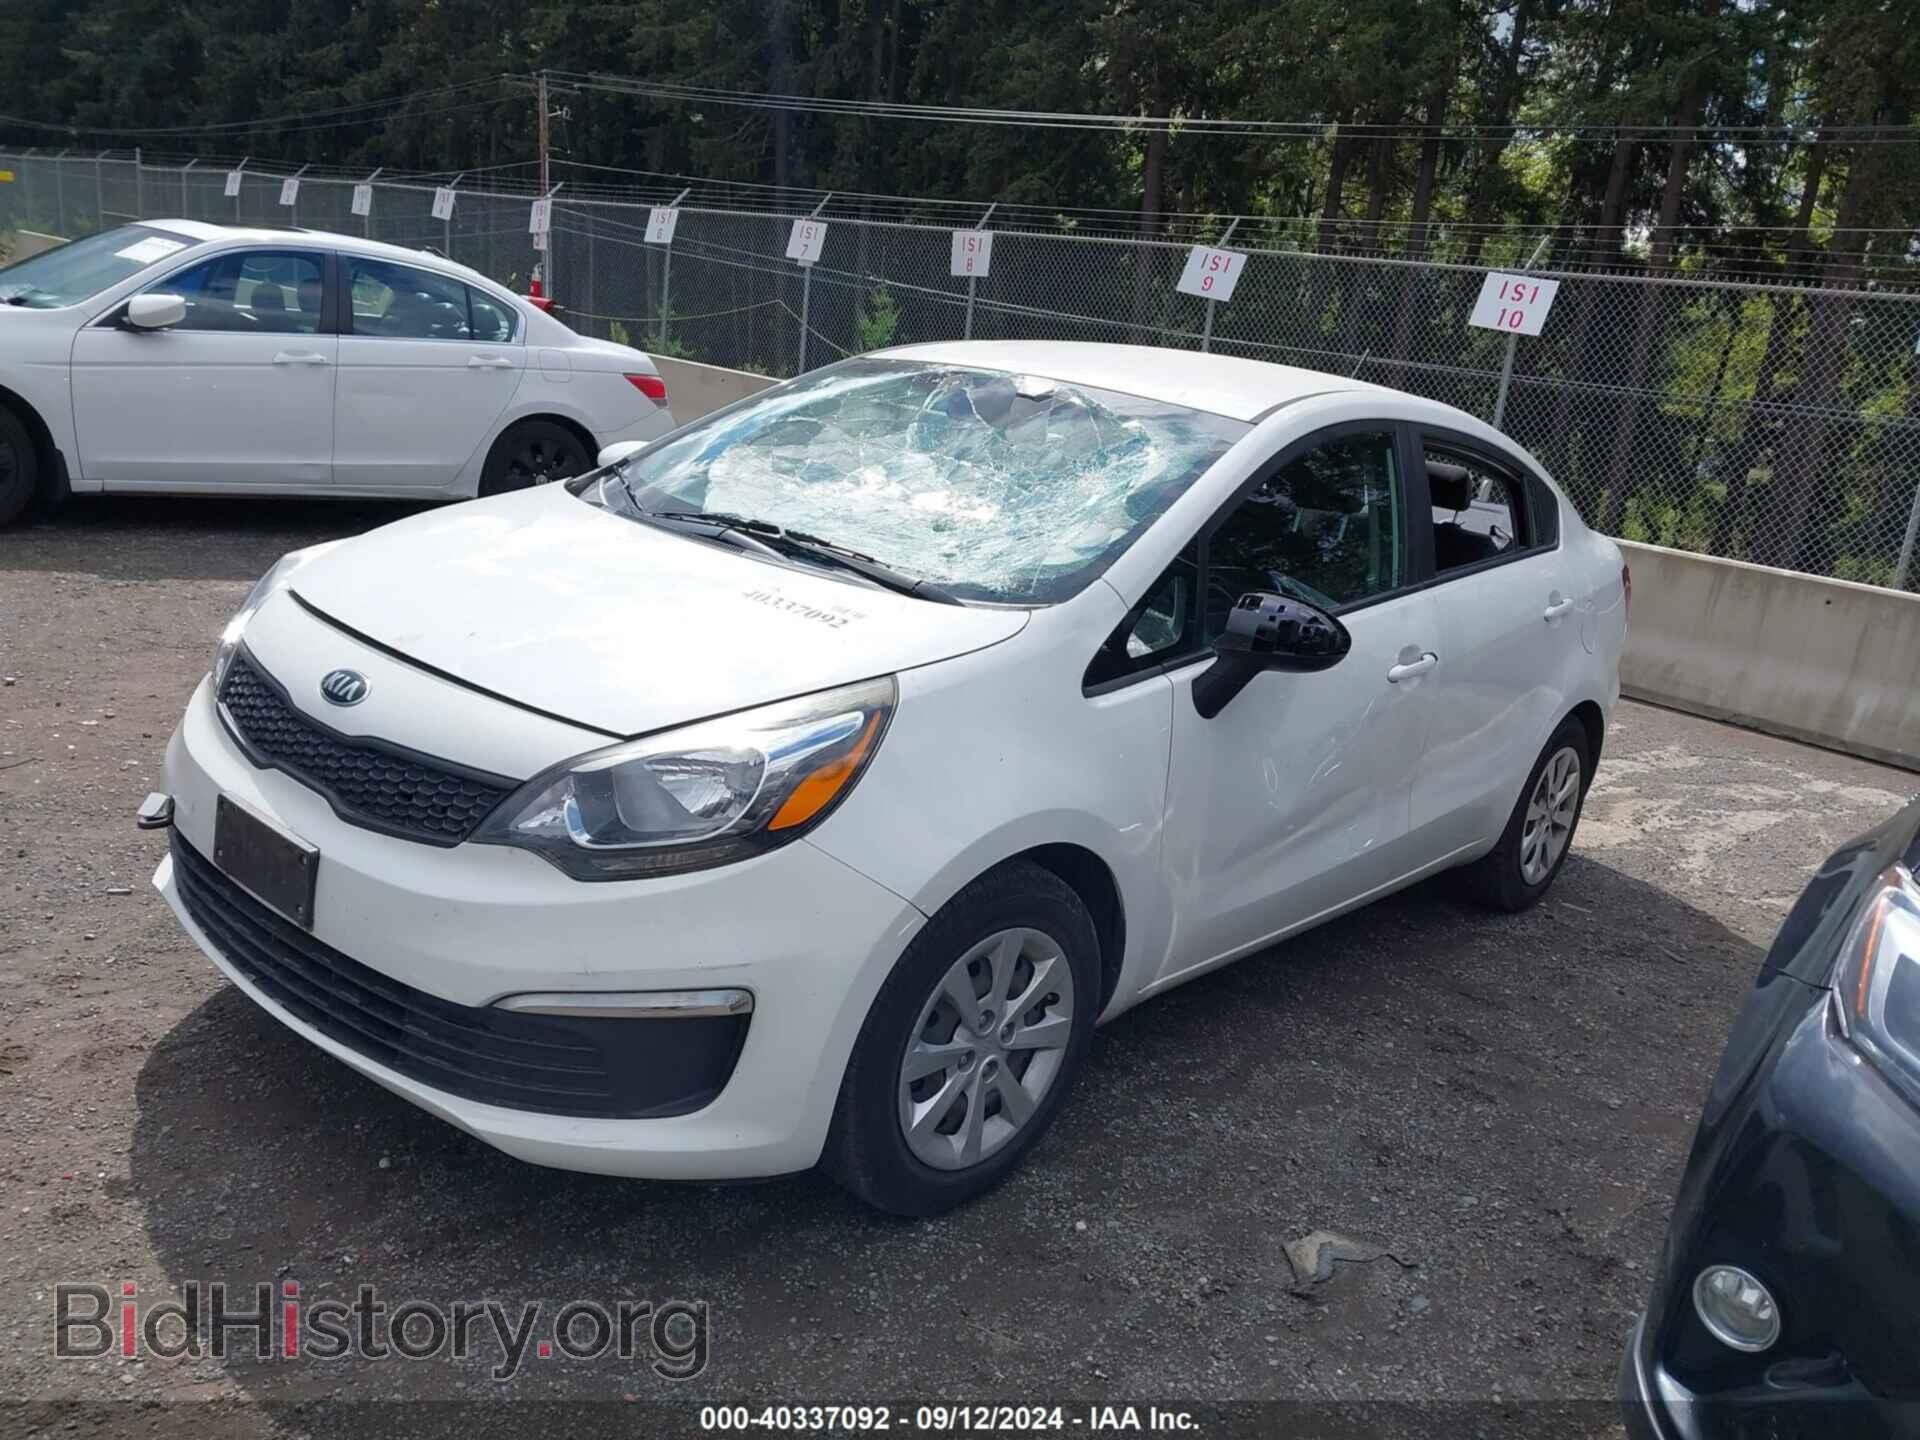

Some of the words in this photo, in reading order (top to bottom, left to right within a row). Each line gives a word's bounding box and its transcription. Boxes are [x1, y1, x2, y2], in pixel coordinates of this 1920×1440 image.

[800, 244, 809, 257] 7
[965, 258, 974, 272] 8
[1201, 275, 1215, 292] 9
[1497, 308, 1524, 329] 10
[323, 671, 361, 701] KIA
